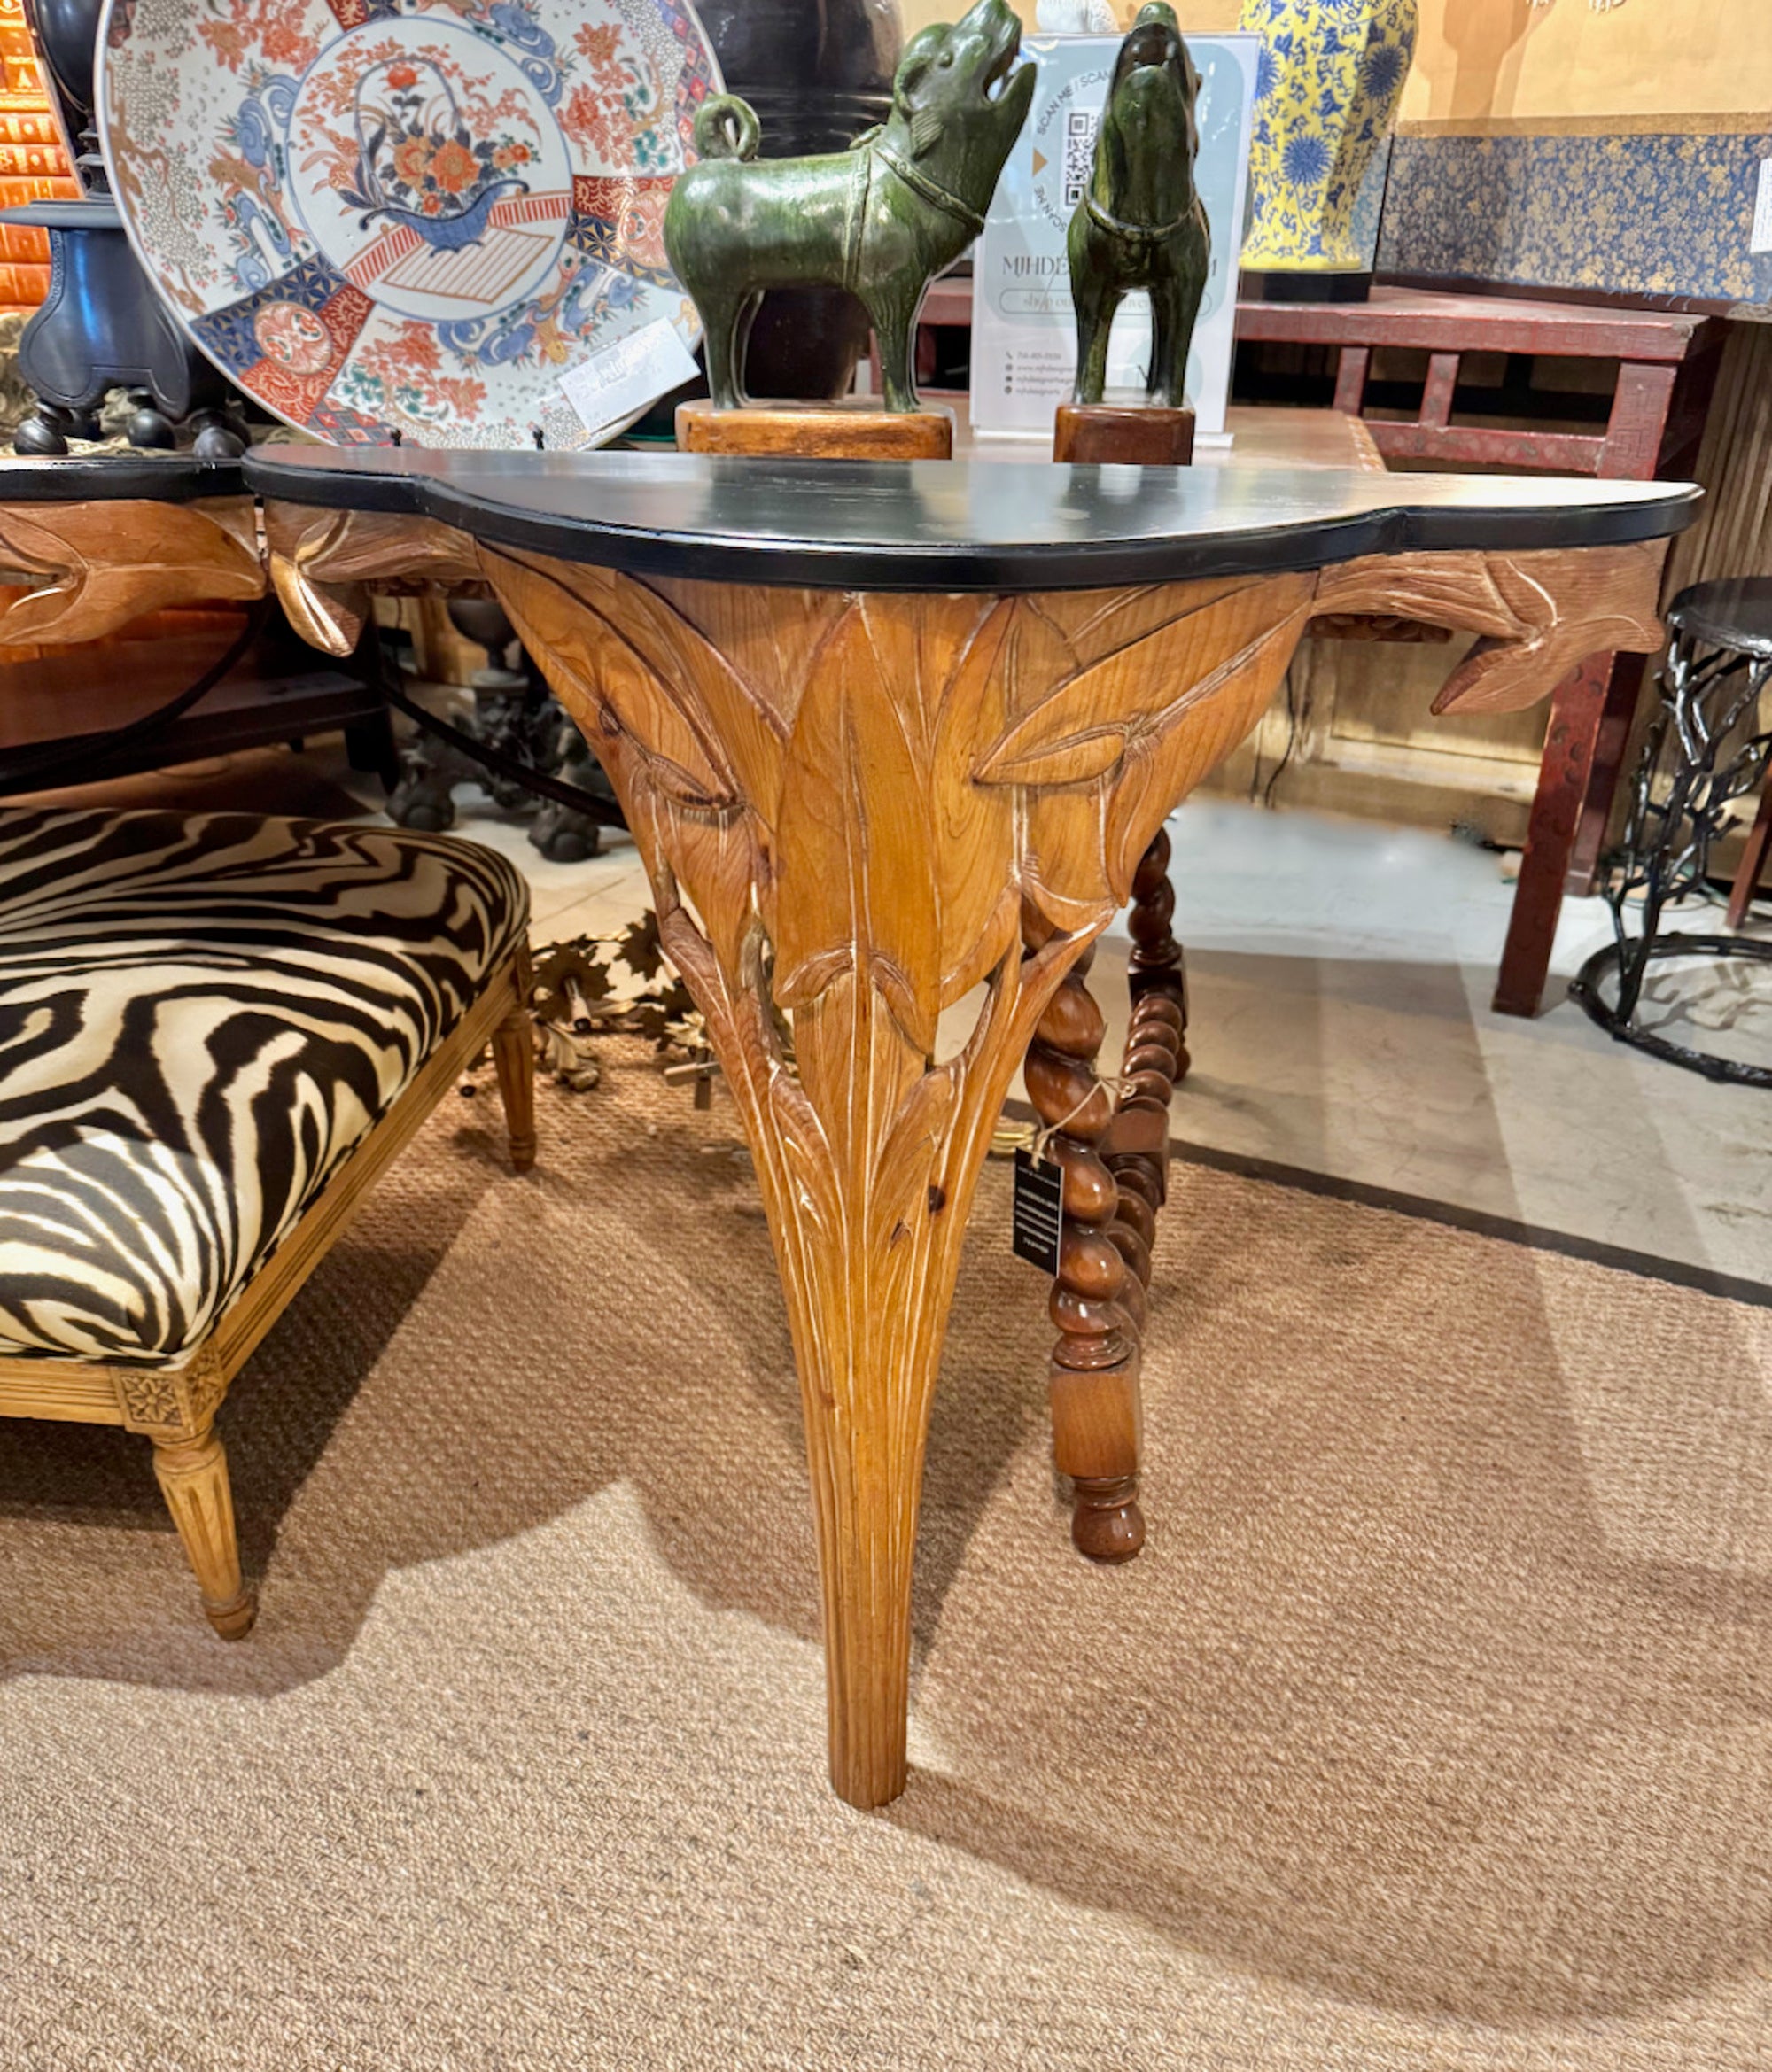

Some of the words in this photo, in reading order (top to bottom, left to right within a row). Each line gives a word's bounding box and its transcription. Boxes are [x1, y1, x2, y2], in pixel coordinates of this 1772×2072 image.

[1037, 100, 1060, 135] SCAN
[1057, 84, 1074, 104] ME
[1042, 203, 1067, 233] SCAN
